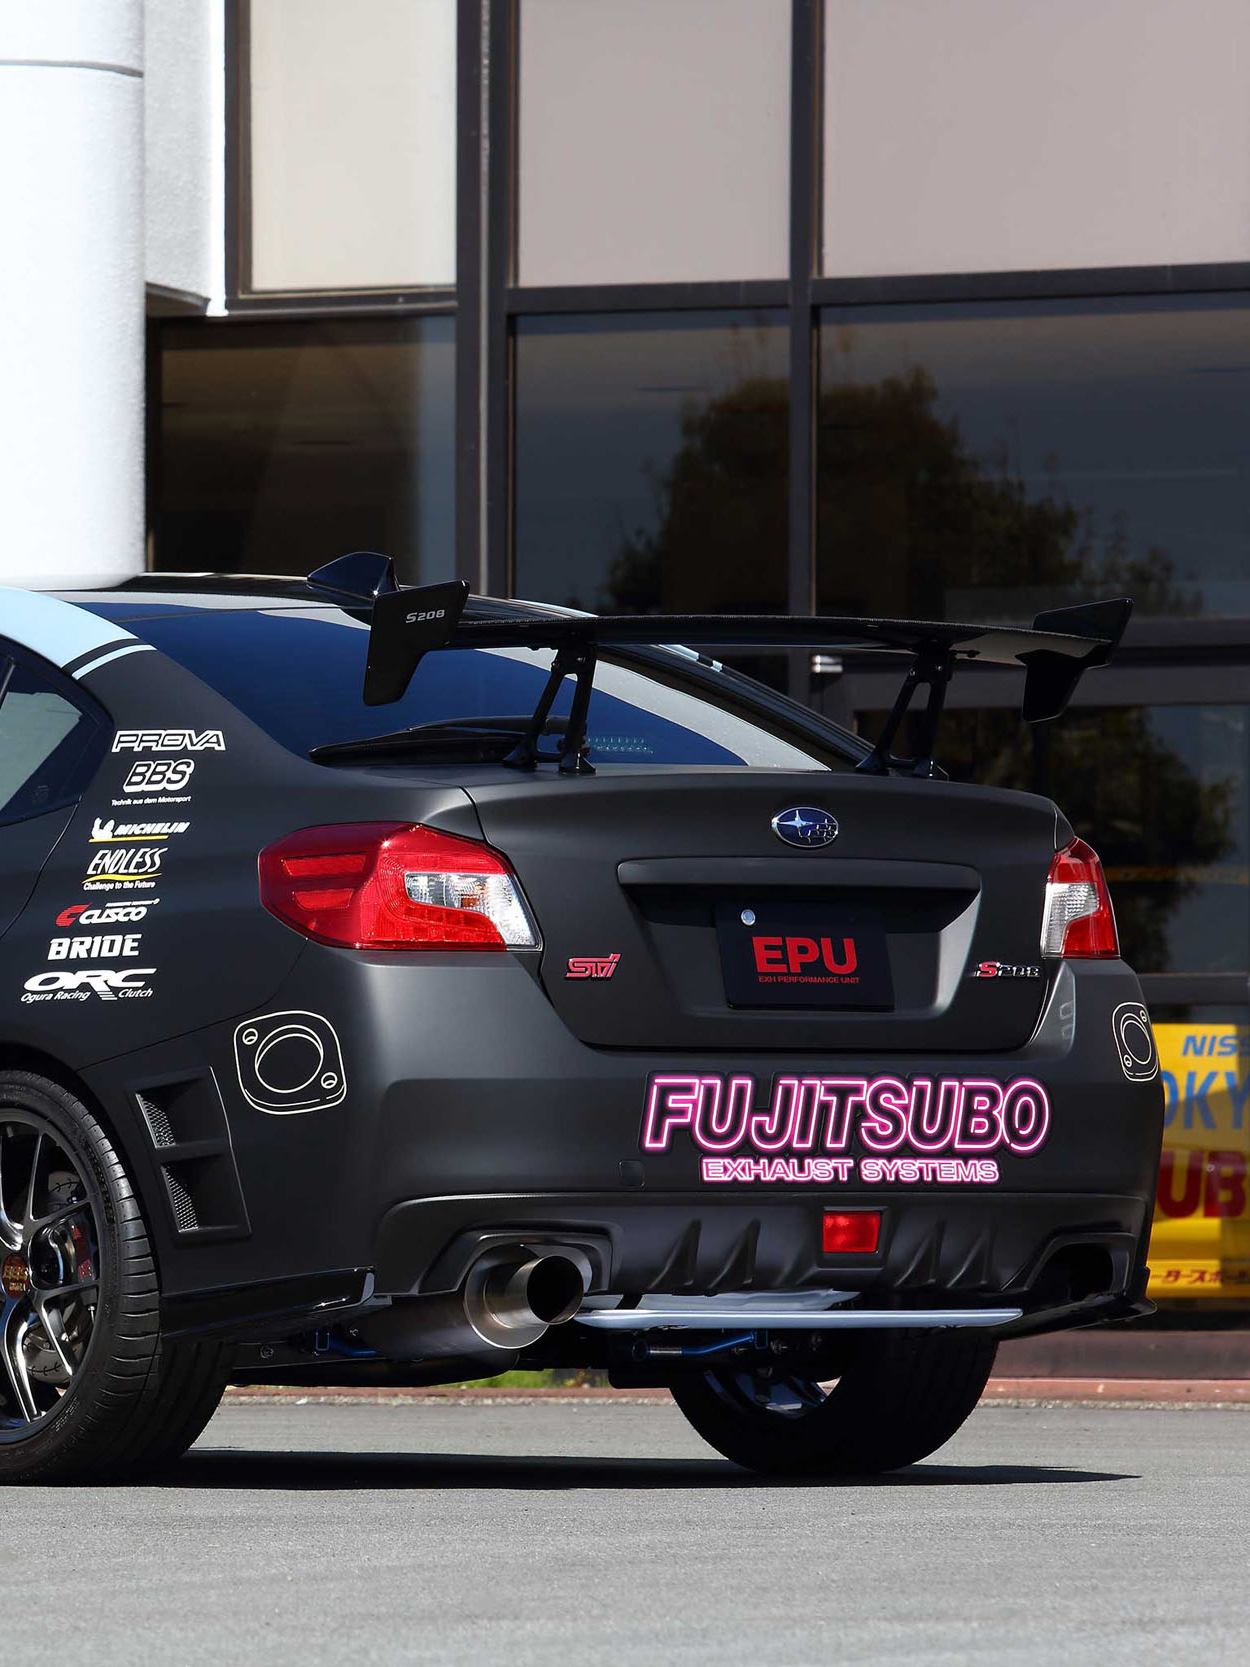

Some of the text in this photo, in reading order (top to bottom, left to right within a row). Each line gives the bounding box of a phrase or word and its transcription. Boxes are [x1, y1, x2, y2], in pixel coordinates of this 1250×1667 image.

[405, 609, 445, 623] S208
[111, 729, 226, 753] PROVA
[123, 759, 195, 793] BBS
[114, 822, 190, 835] MICHELIN
[87, 847, 168, 874] ENDLESS
[83, 880, 155, 891] Challenge to the Future
[79, 906, 148, 925] CUSCO
[47, 933, 143, 961] BRIDE
[752, 936, 858, 975] EPU
[23, 968, 157, 1001] ORC
[778, 976, 839, 984] PERFORMANCE
[20, 988, 153, 1004] Ogura Racing Clutch
[643, 1075, 1051, 1153] FUJITSUBO
[700, 1157, 1000, 1183] EXHAUST SYSTEMS
